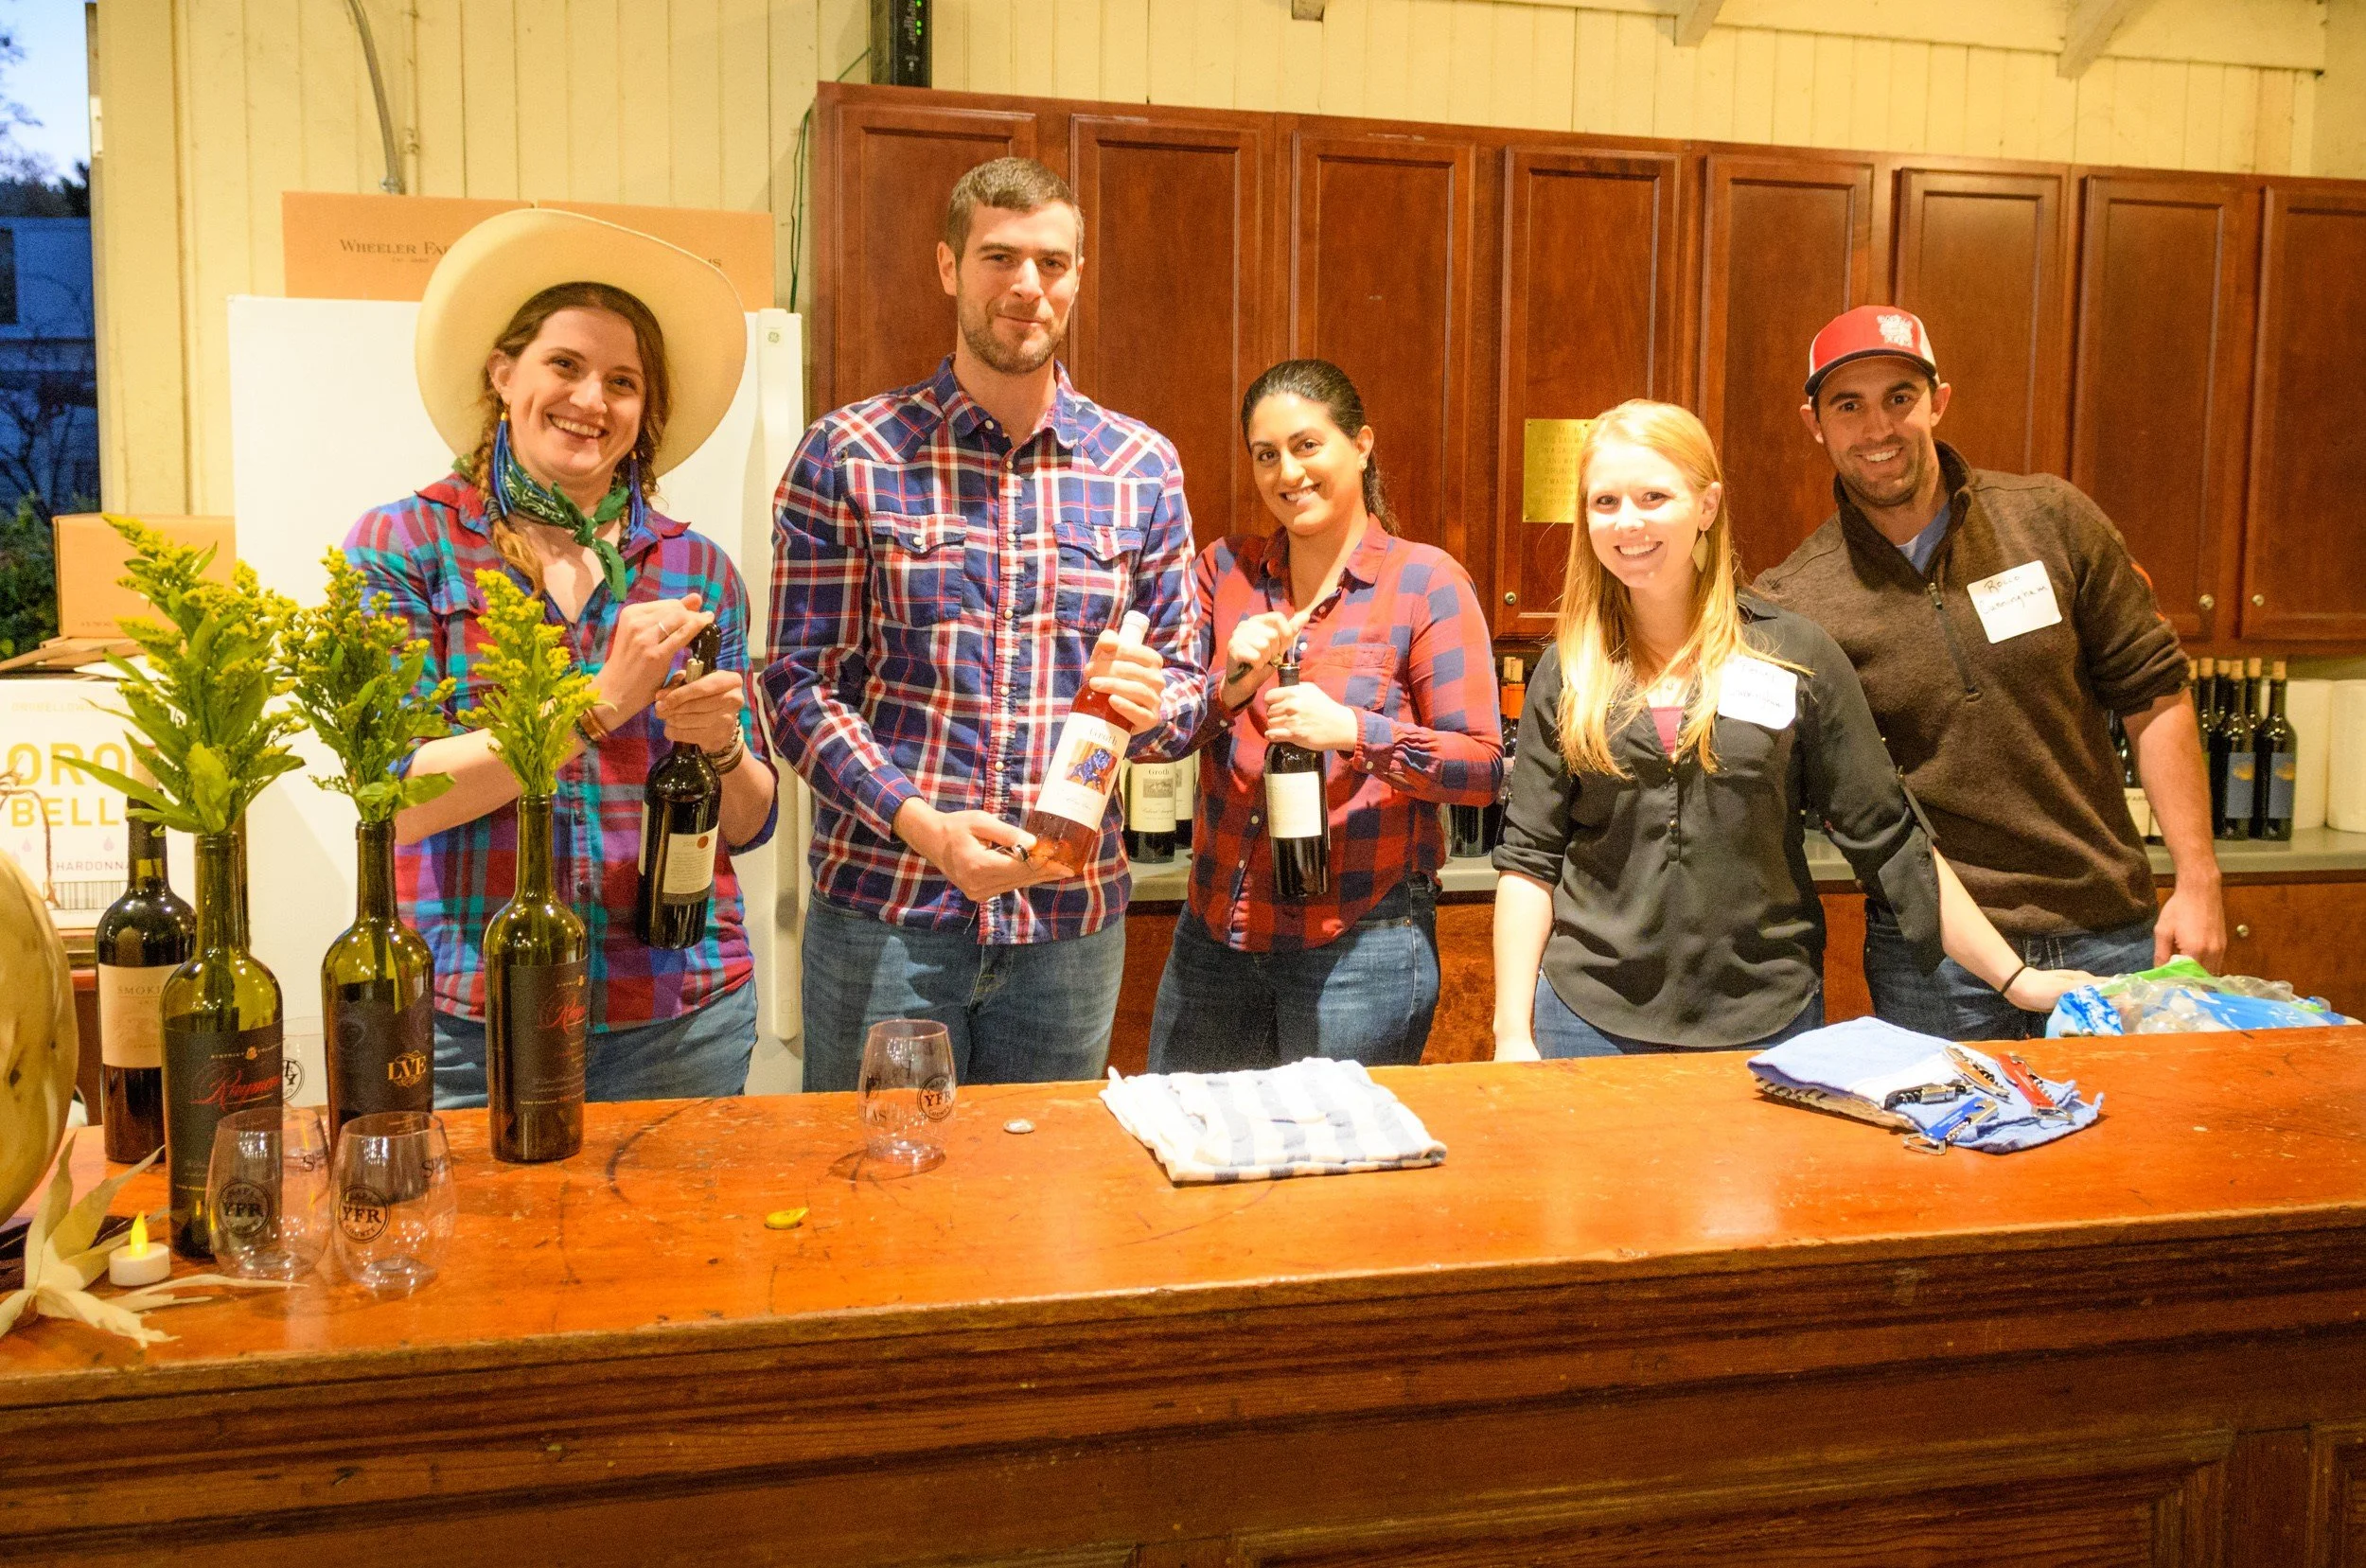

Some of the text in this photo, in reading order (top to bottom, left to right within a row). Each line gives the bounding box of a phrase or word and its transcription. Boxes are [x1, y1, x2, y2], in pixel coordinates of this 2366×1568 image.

[340, 238, 416, 255] WHEELER
[1089, 727, 1118, 748] Groth
[8, 742, 127, 786] ORO
[1148, 767, 1170, 776] Groth
[11, 798, 128, 828] BELL
[117, 985, 161, 995] SMOKI
[924, 1090, 951, 1108] YFR
[343, 1206, 382, 1224] YFR
